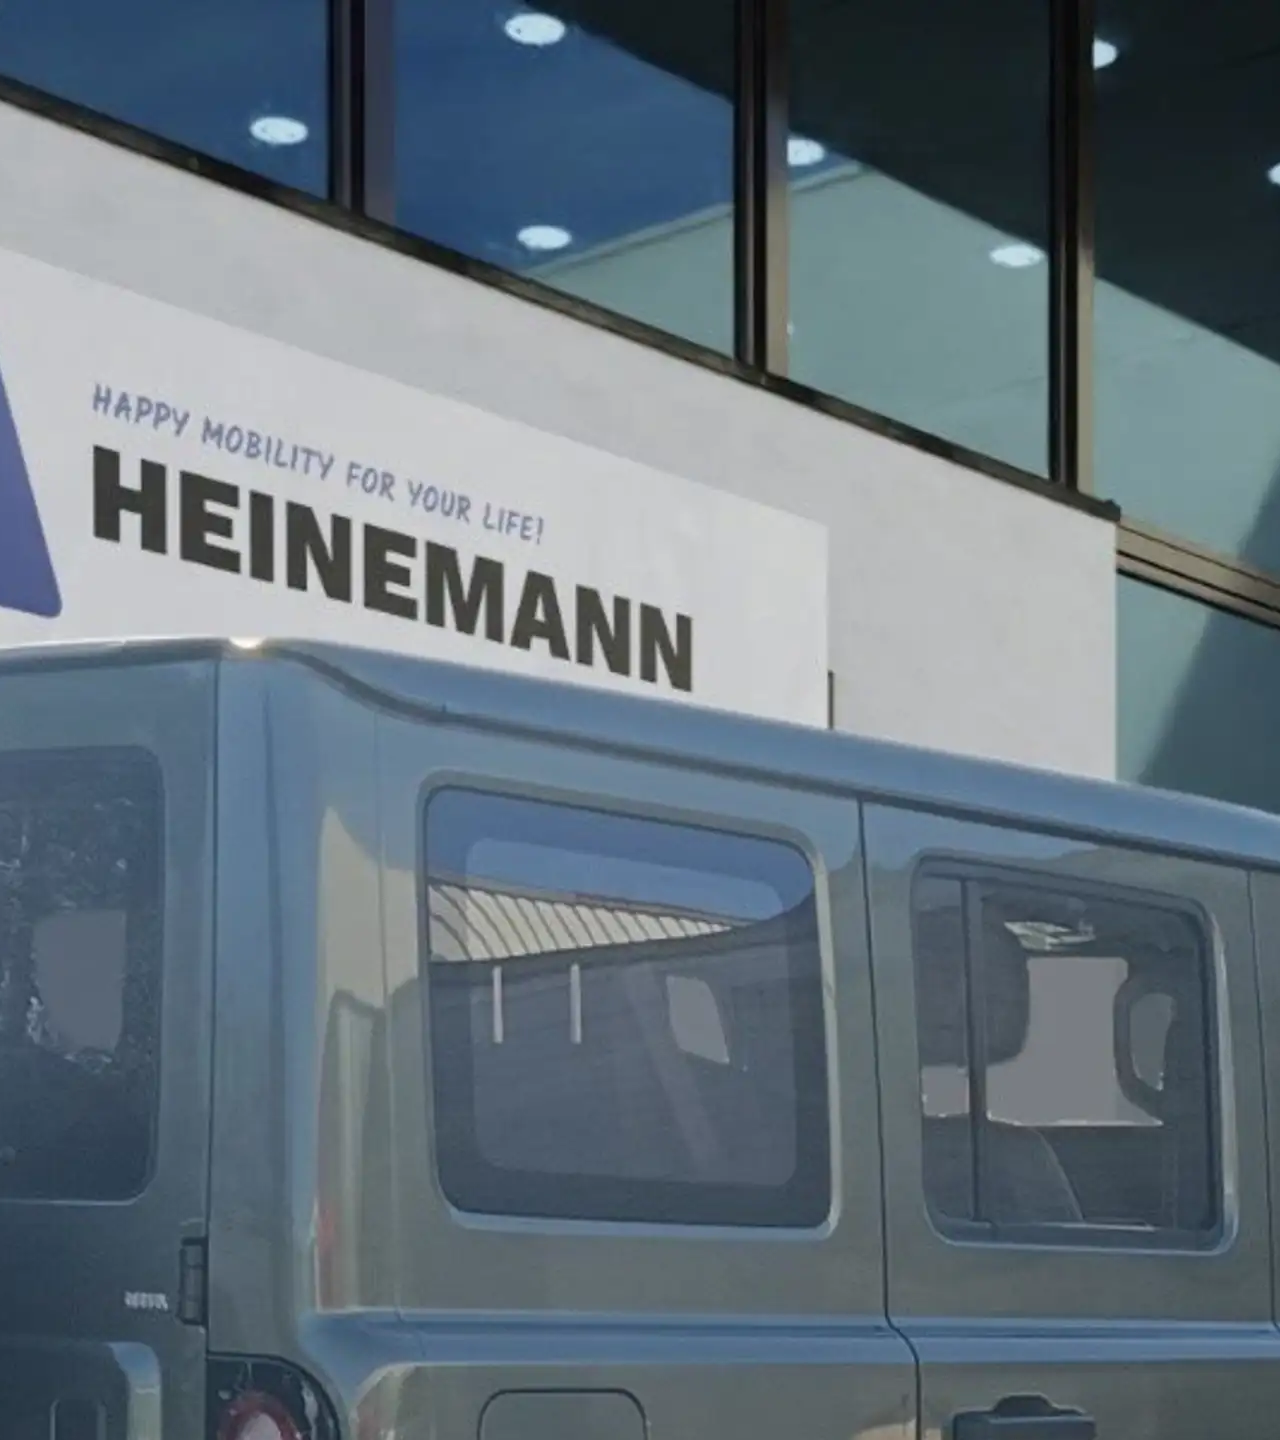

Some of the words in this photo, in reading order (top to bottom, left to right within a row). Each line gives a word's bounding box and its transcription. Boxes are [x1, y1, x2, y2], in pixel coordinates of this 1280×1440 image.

[93, 383, 189, 437] HAPPY
[201, 416, 334, 480] MOBILITY
[347, 461, 395, 501] FOR
[407, 480, 471, 523] YOUR
[483, 503, 543, 544] LIFE!
[93, 445, 693, 692] HEINEMANN
